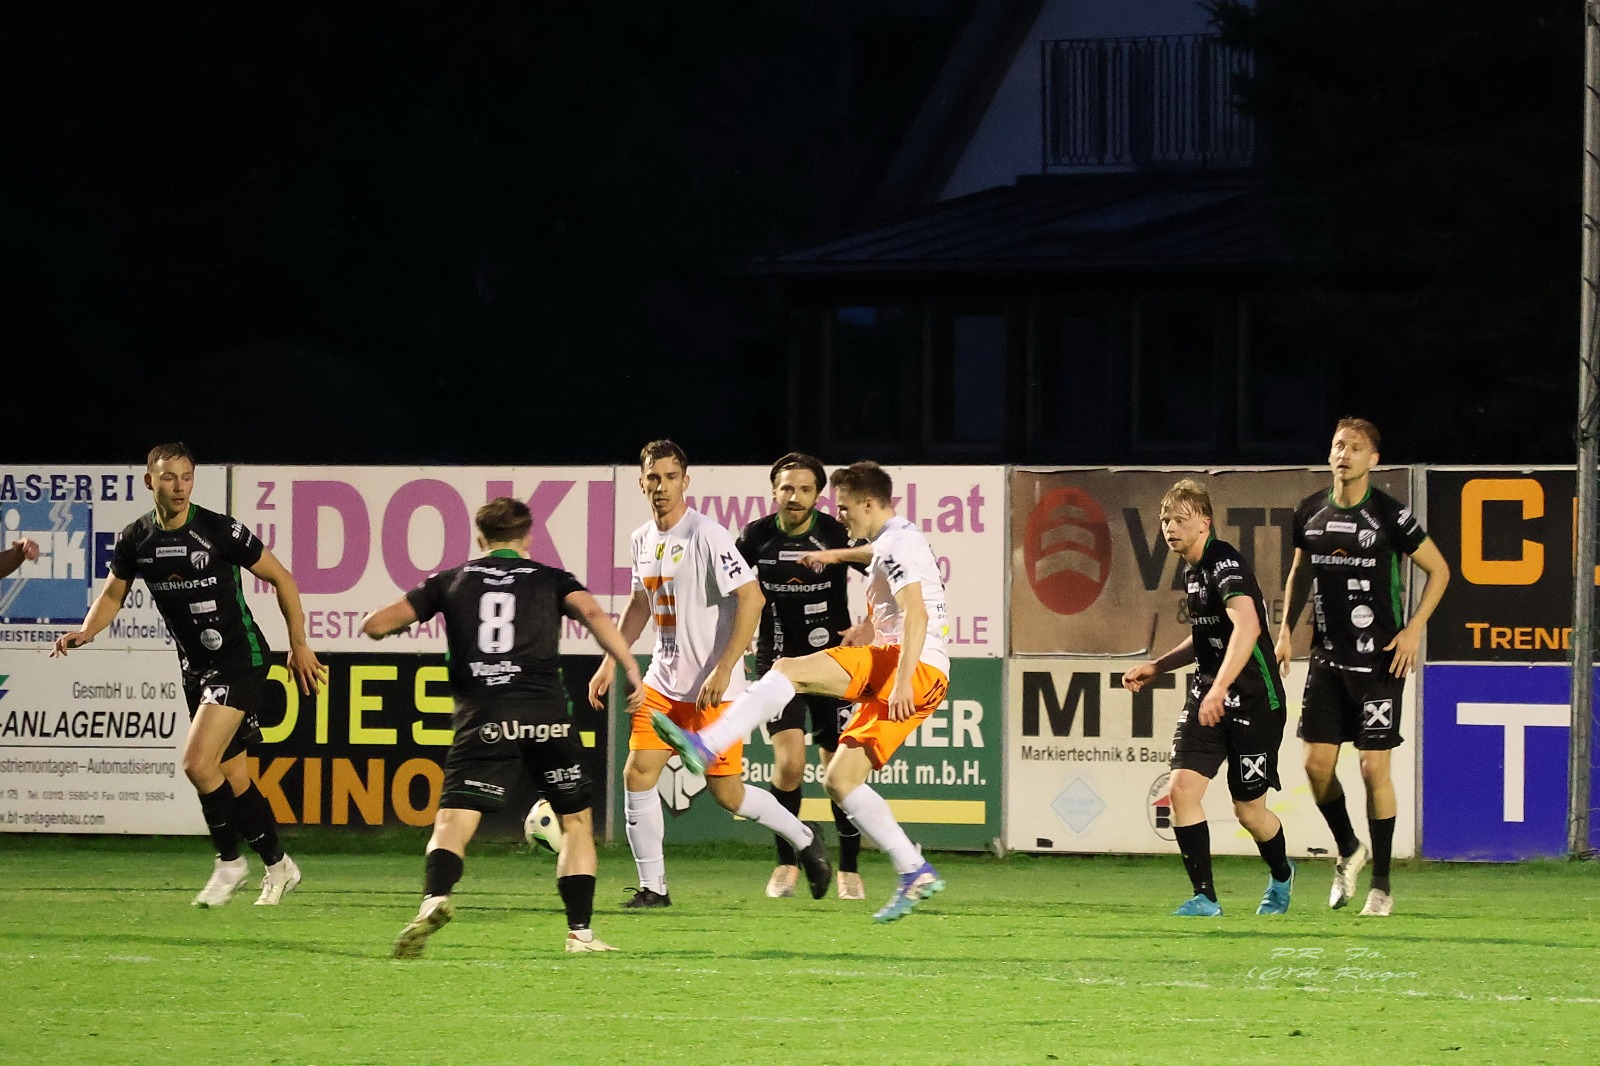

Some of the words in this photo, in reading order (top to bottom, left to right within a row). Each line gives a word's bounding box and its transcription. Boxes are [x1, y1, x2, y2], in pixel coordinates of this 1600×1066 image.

[478, 592, 517, 654] 8
[141, 682, 156, 699] Co
[160, 682, 176, 699] KG
[501, 720, 571, 743] Unger
[1021, 745, 1123, 762] Markiertechnik
[1126, 747, 1136, 762] &
